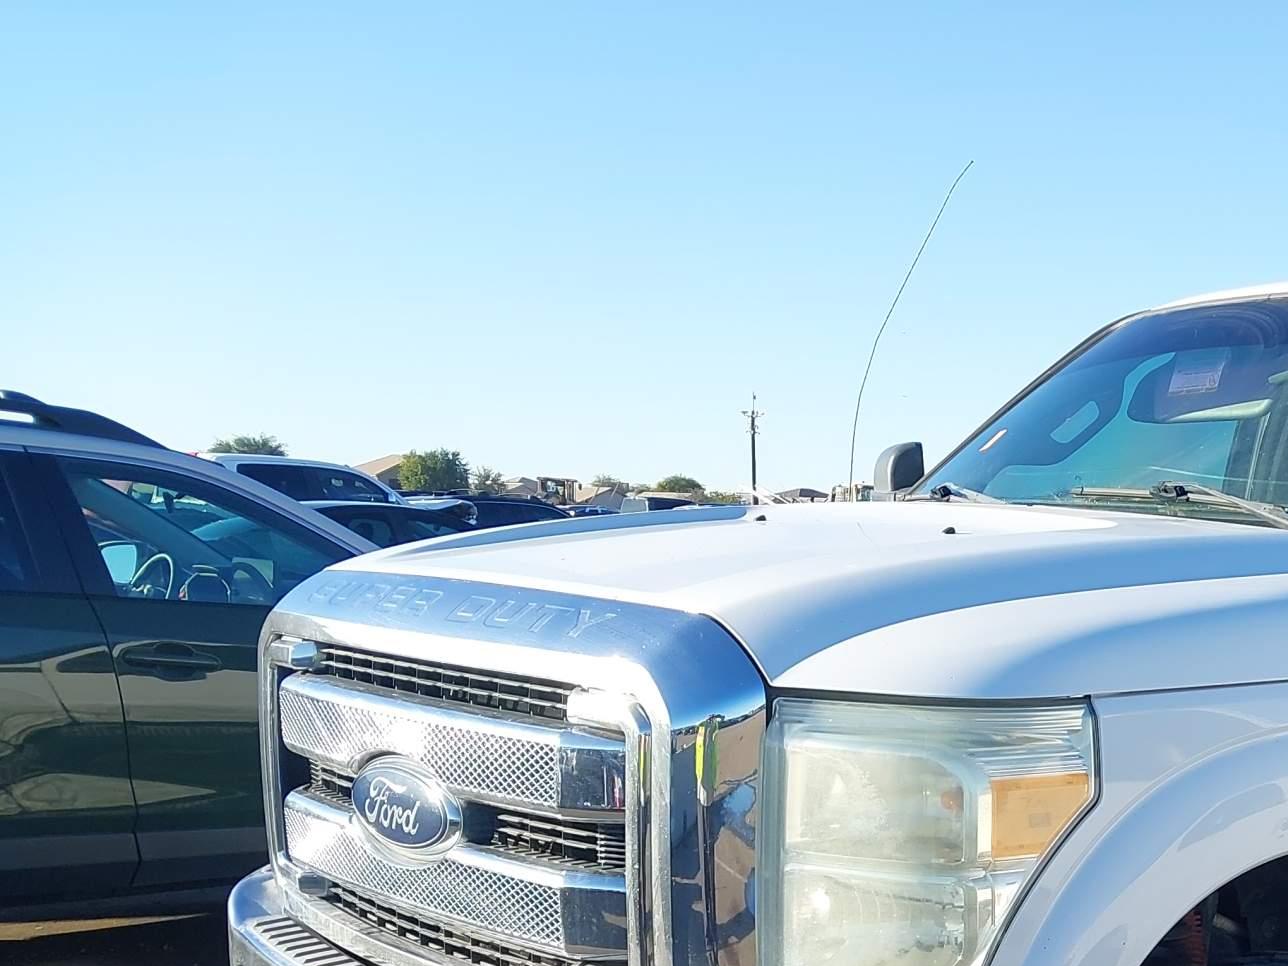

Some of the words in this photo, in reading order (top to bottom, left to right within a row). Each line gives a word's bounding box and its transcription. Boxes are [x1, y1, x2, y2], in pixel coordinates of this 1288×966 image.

[310, 581, 444, 617] SUPER
[444, 594, 619, 639] DUTY
[365, 776, 420, 836] Ford
